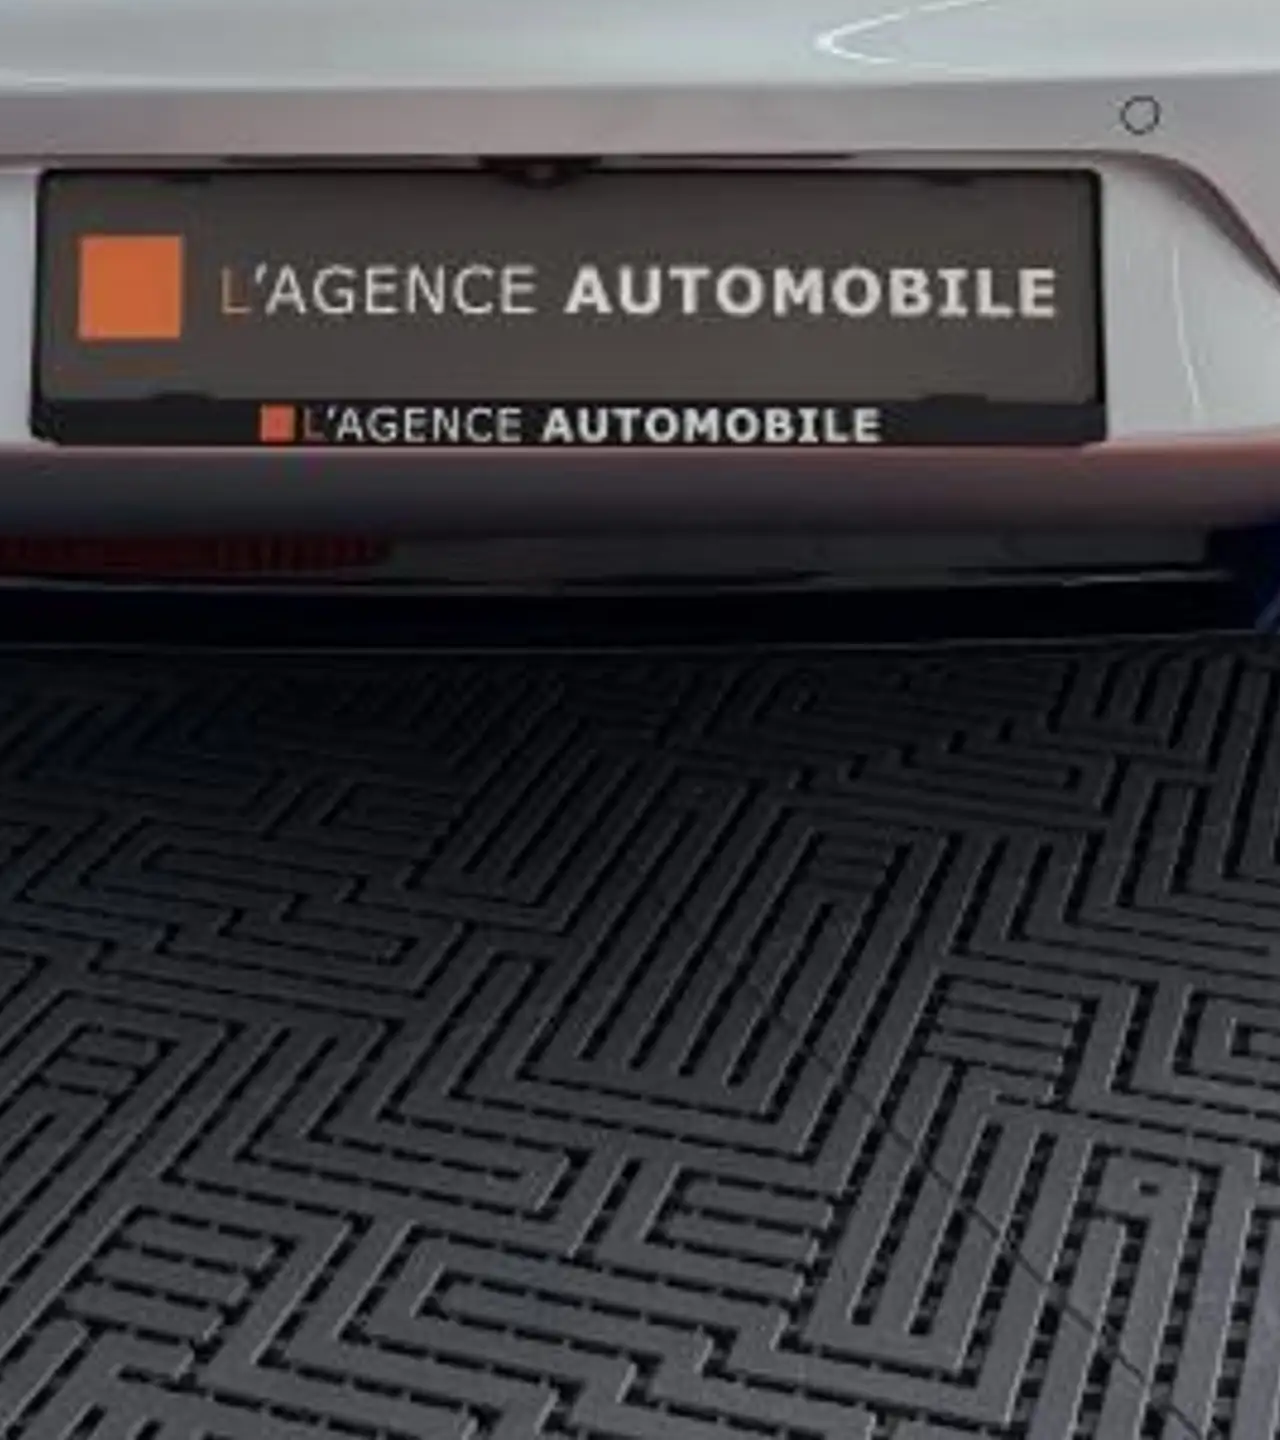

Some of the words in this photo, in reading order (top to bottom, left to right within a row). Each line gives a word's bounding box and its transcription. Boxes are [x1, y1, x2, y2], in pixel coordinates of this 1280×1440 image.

[221, 261, 537, 315] L'AGENCE
[563, 264, 1057, 318] AUTOMOBILE
[303, 405, 523, 444] L'AGENCE
[541, 407, 882, 444] AUTOMOBILE
